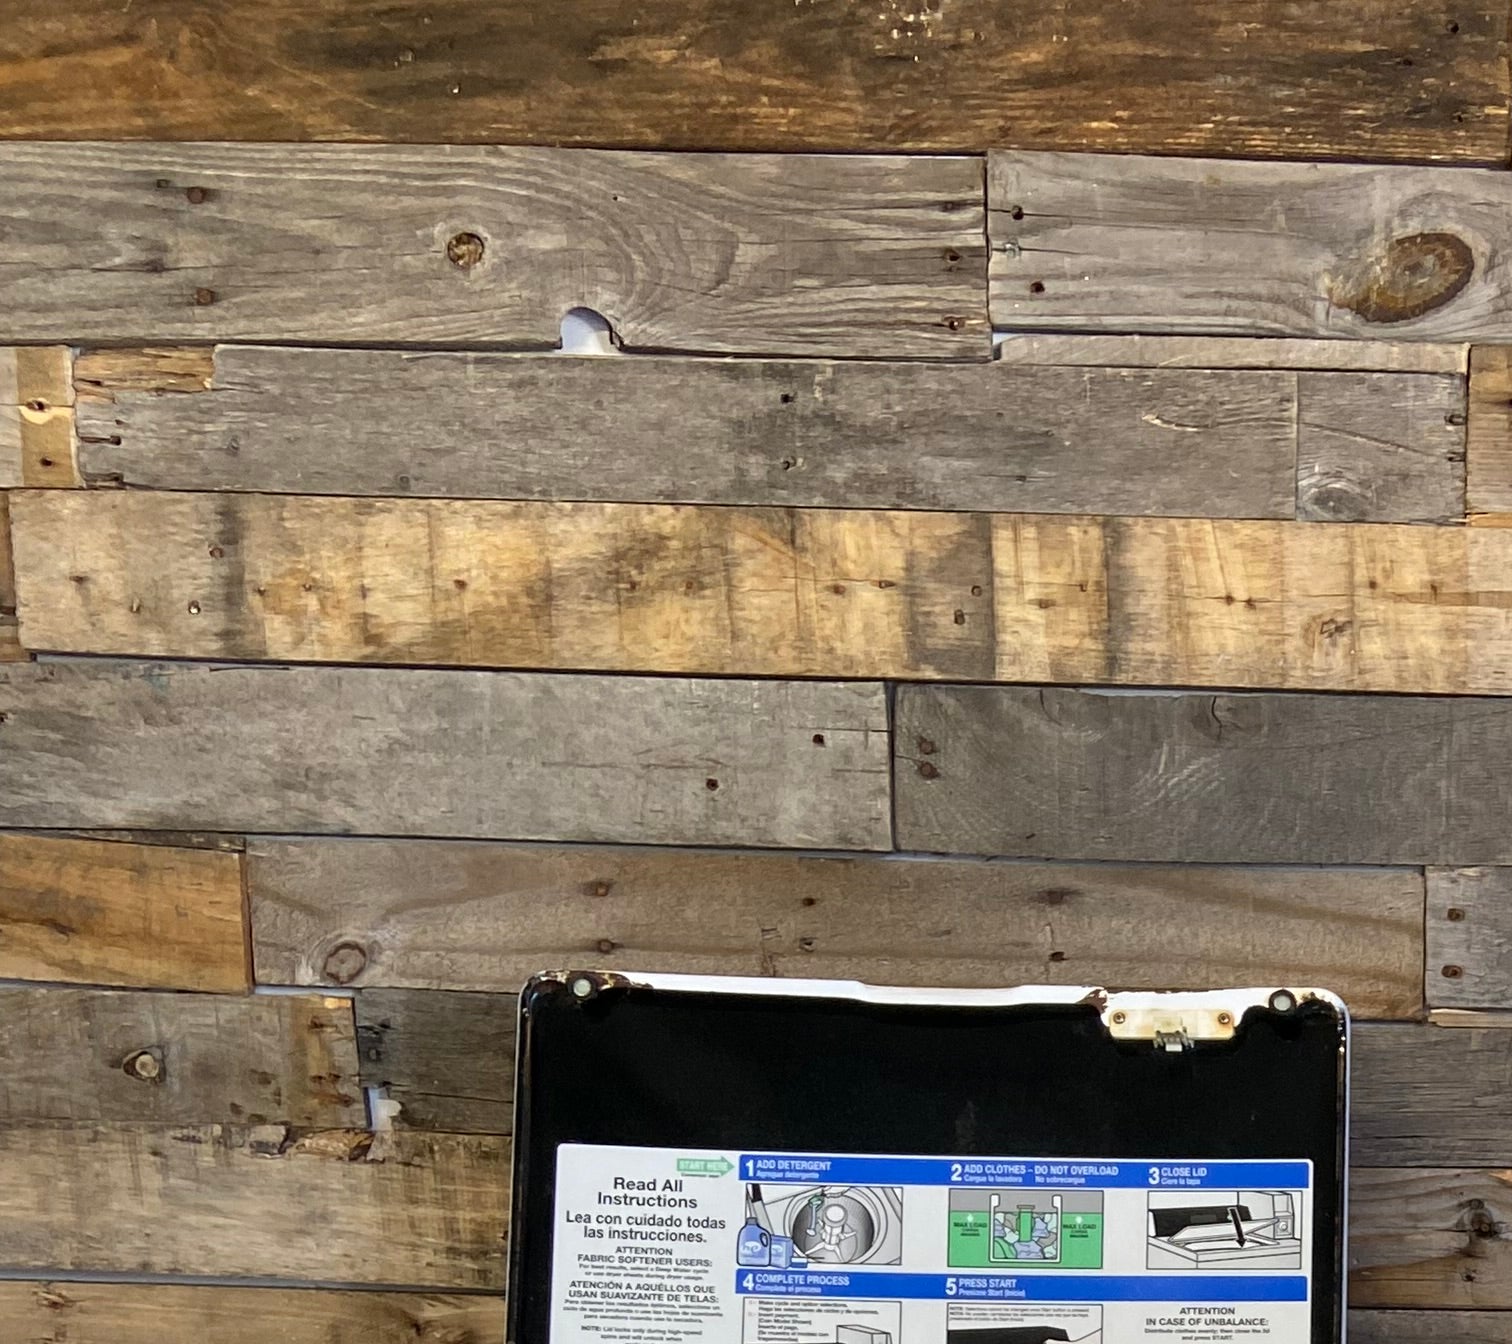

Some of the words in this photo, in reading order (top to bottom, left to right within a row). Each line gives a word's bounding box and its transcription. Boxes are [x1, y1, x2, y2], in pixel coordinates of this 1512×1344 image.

[746, 1159, 754, 1177] 1
[756, 1160, 776, 1169] ADD
[778, 1161, 832, 1171] DETERGENT
[951, 1164, 962, 1181] 2
[964, 1164, 984, 1174] ADD
[985, 1164, 1026, 1174] CLOTHES
[1034, 1165, 1048, 1175] DO
[1050, 1165, 1068, 1175] NOT
[1071, 1166, 1119, 1176] OVERLOAD
[1161, 1167, 1190, 1177] CLOSE
[1192, 1167, 1207, 1177] LID
[1149, 1167, 1160, 1184] 3
[614, 1177, 656, 1191] Read
[662, 1179, 683, 1192] All
[598, 1192, 697, 1208] Instructions
[566, 1211, 591, 1223] Lea
[596, 1214, 622, 1224] con
[626, 1213, 682, 1228] cuidado
[687, 1216, 726, 1229] todas
[584, 1226, 604, 1239] las
[609, 1228, 707, 1243] instrucciones.
[615, 1246, 673, 1255] ATTENTION
[577, 1254, 615, 1263] FABRIC
[618, 1256, 672, 1265] SOFTENER
[675, 1257, 712, 1267] USERS:
[569, 1279, 623, 1290] ATENCIÓN
[625, 1282, 632, 1290] A
[635, 1281, 690, 1293] AQUÉLLOS
[693, 1285, 715, 1294] QUE
[743, 1273, 754, 1290] 4
[755, 1274, 804, 1284] COMPLETE
[807, 1275, 850, 1285] PROCESS
[946, 1278, 957, 1295] 5
[959, 1279, 987, 1288] PRESS
[989, 1279, 1017, 1288] START
[568, 1290, 597, 1298] USAN
[600, 1291, 665, 1301] SUAVIZANTE
[667, 1293, 681, 1302] DE
[683, 1294, 719, 1303] TELAS:
[1179, 1307, 1235, 1315] ATTENTION
[1146, 1318, 1156, 1326] IN
[1159, 1318, 1185, 1326] CASE
[1188, 1318, 1202, 1326] OF
[1205, 1318, 1269, 1326] UNBALANCE:
